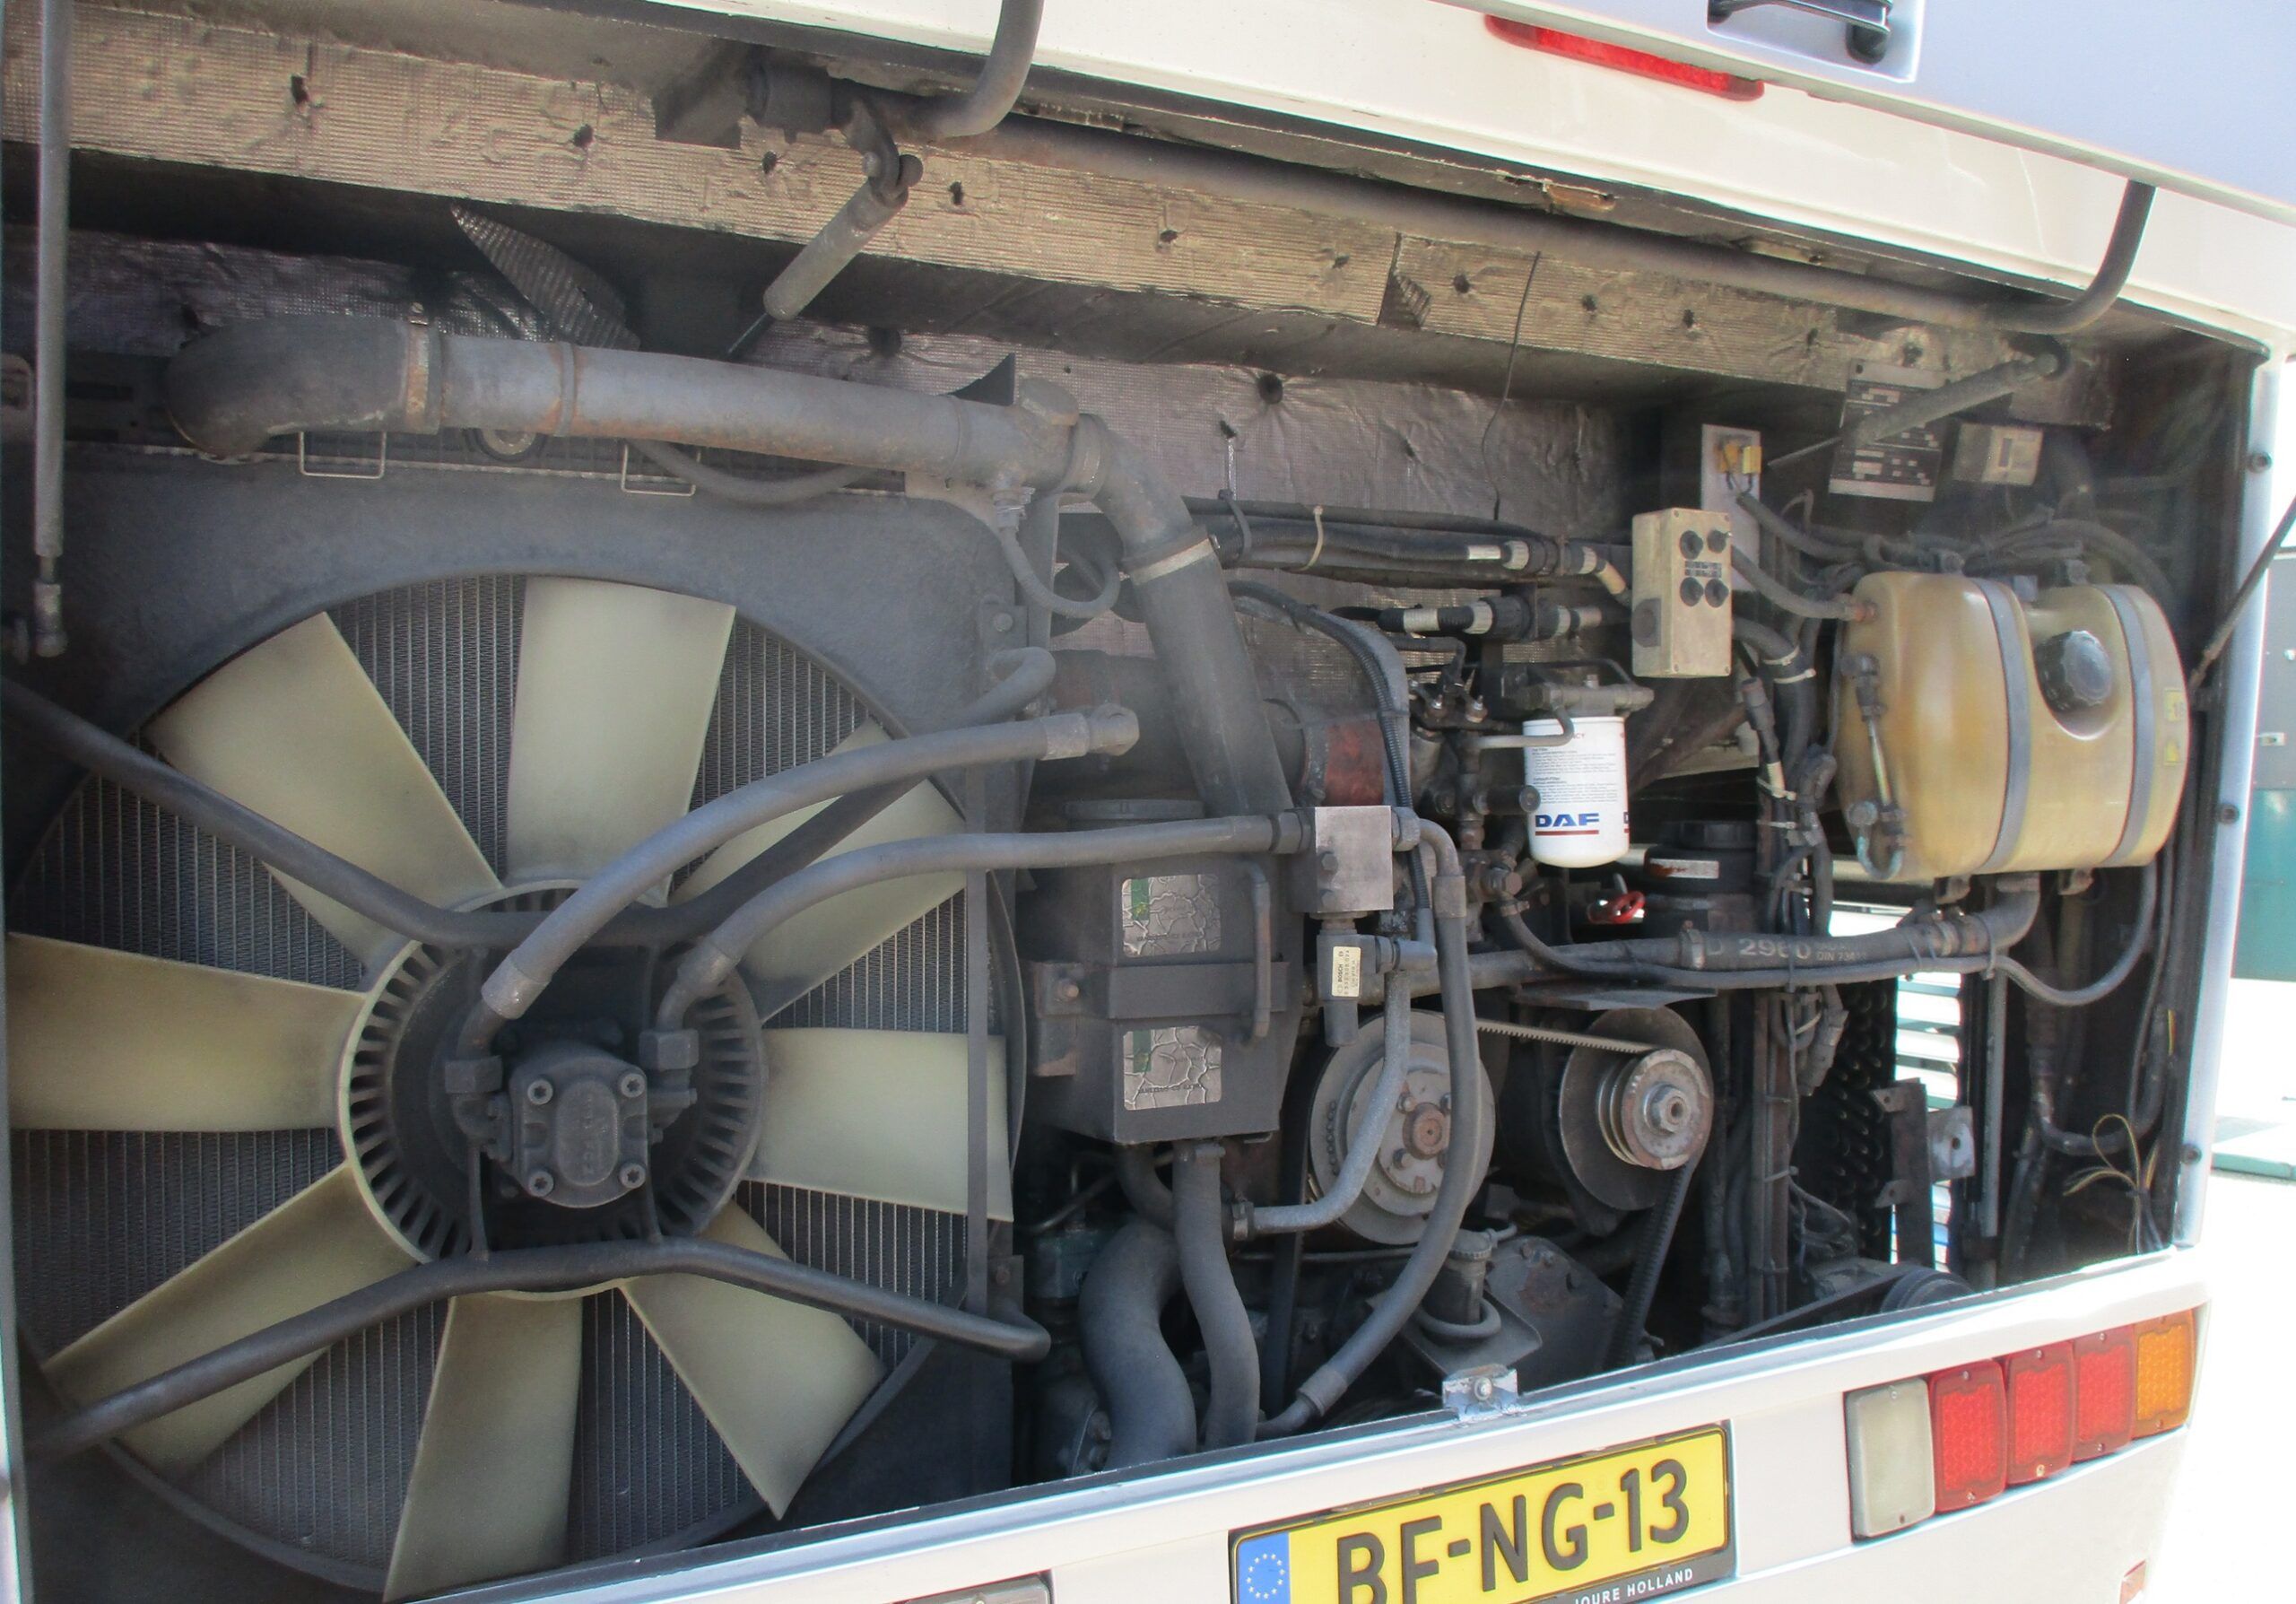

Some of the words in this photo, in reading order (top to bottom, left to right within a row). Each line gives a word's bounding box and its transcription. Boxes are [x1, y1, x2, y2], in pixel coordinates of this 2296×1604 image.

[1535, 813, 1599, 827] DAF
[1336, 1459, 1690, 1604] BF-NG-13
[1627, 1568, 1693, 1597] HOLLAND
